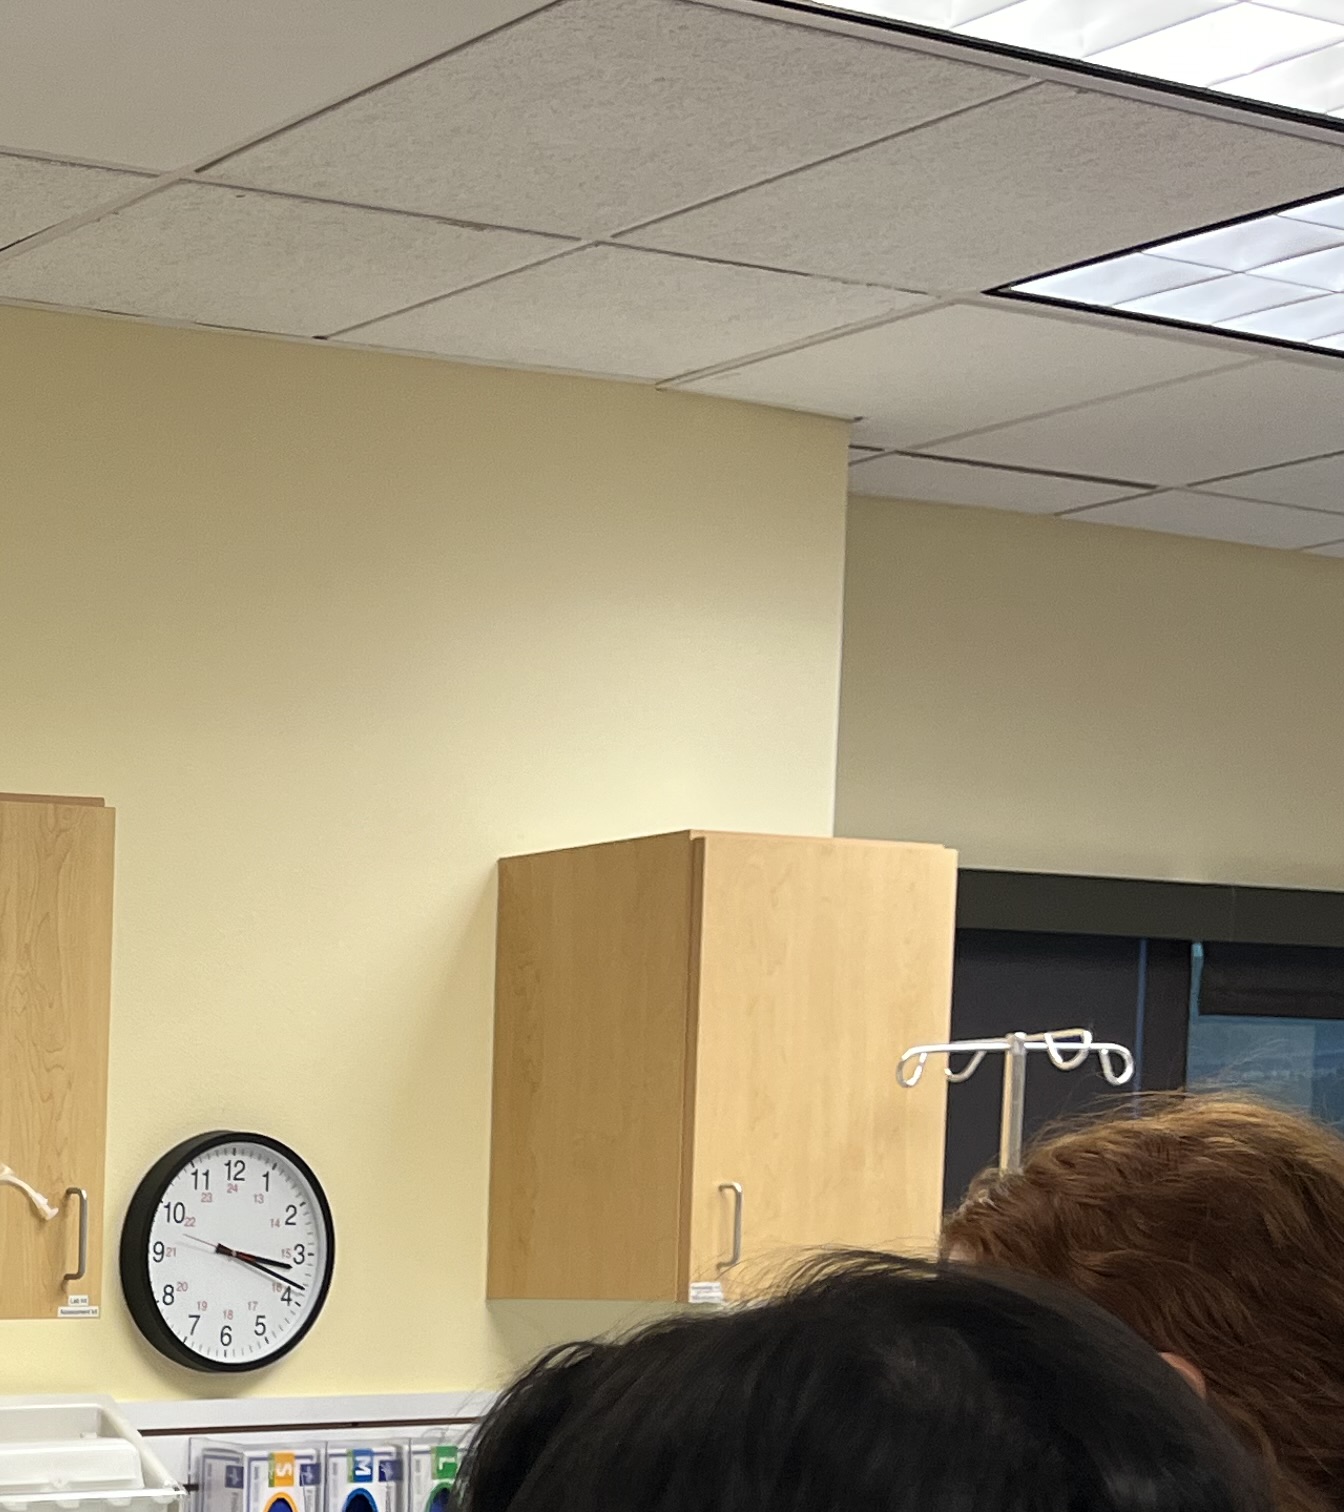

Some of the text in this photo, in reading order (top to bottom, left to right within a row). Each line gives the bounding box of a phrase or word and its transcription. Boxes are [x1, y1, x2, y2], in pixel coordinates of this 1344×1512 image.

[190, 1168, 210, 1191] 11
[223, 1159, 246, 1182] 12
[262, 1171, 270, 1193] 1
[164, 1201, 187, 1224] 10
[284, 1204, 298, 1226] 2
[152, 1241, 165, 1264] 9
[293, 1244, 305, 1265] 3
[162, 1284, 175, 1306] 8
[280, 1286, 293, 1307] 4
[188, 1315, 201, 1336] 7
[220, 1325, 233, 1347] 6
[254, 1315, 266, 1336] 5
[354, 1456, 371, 1476] M
